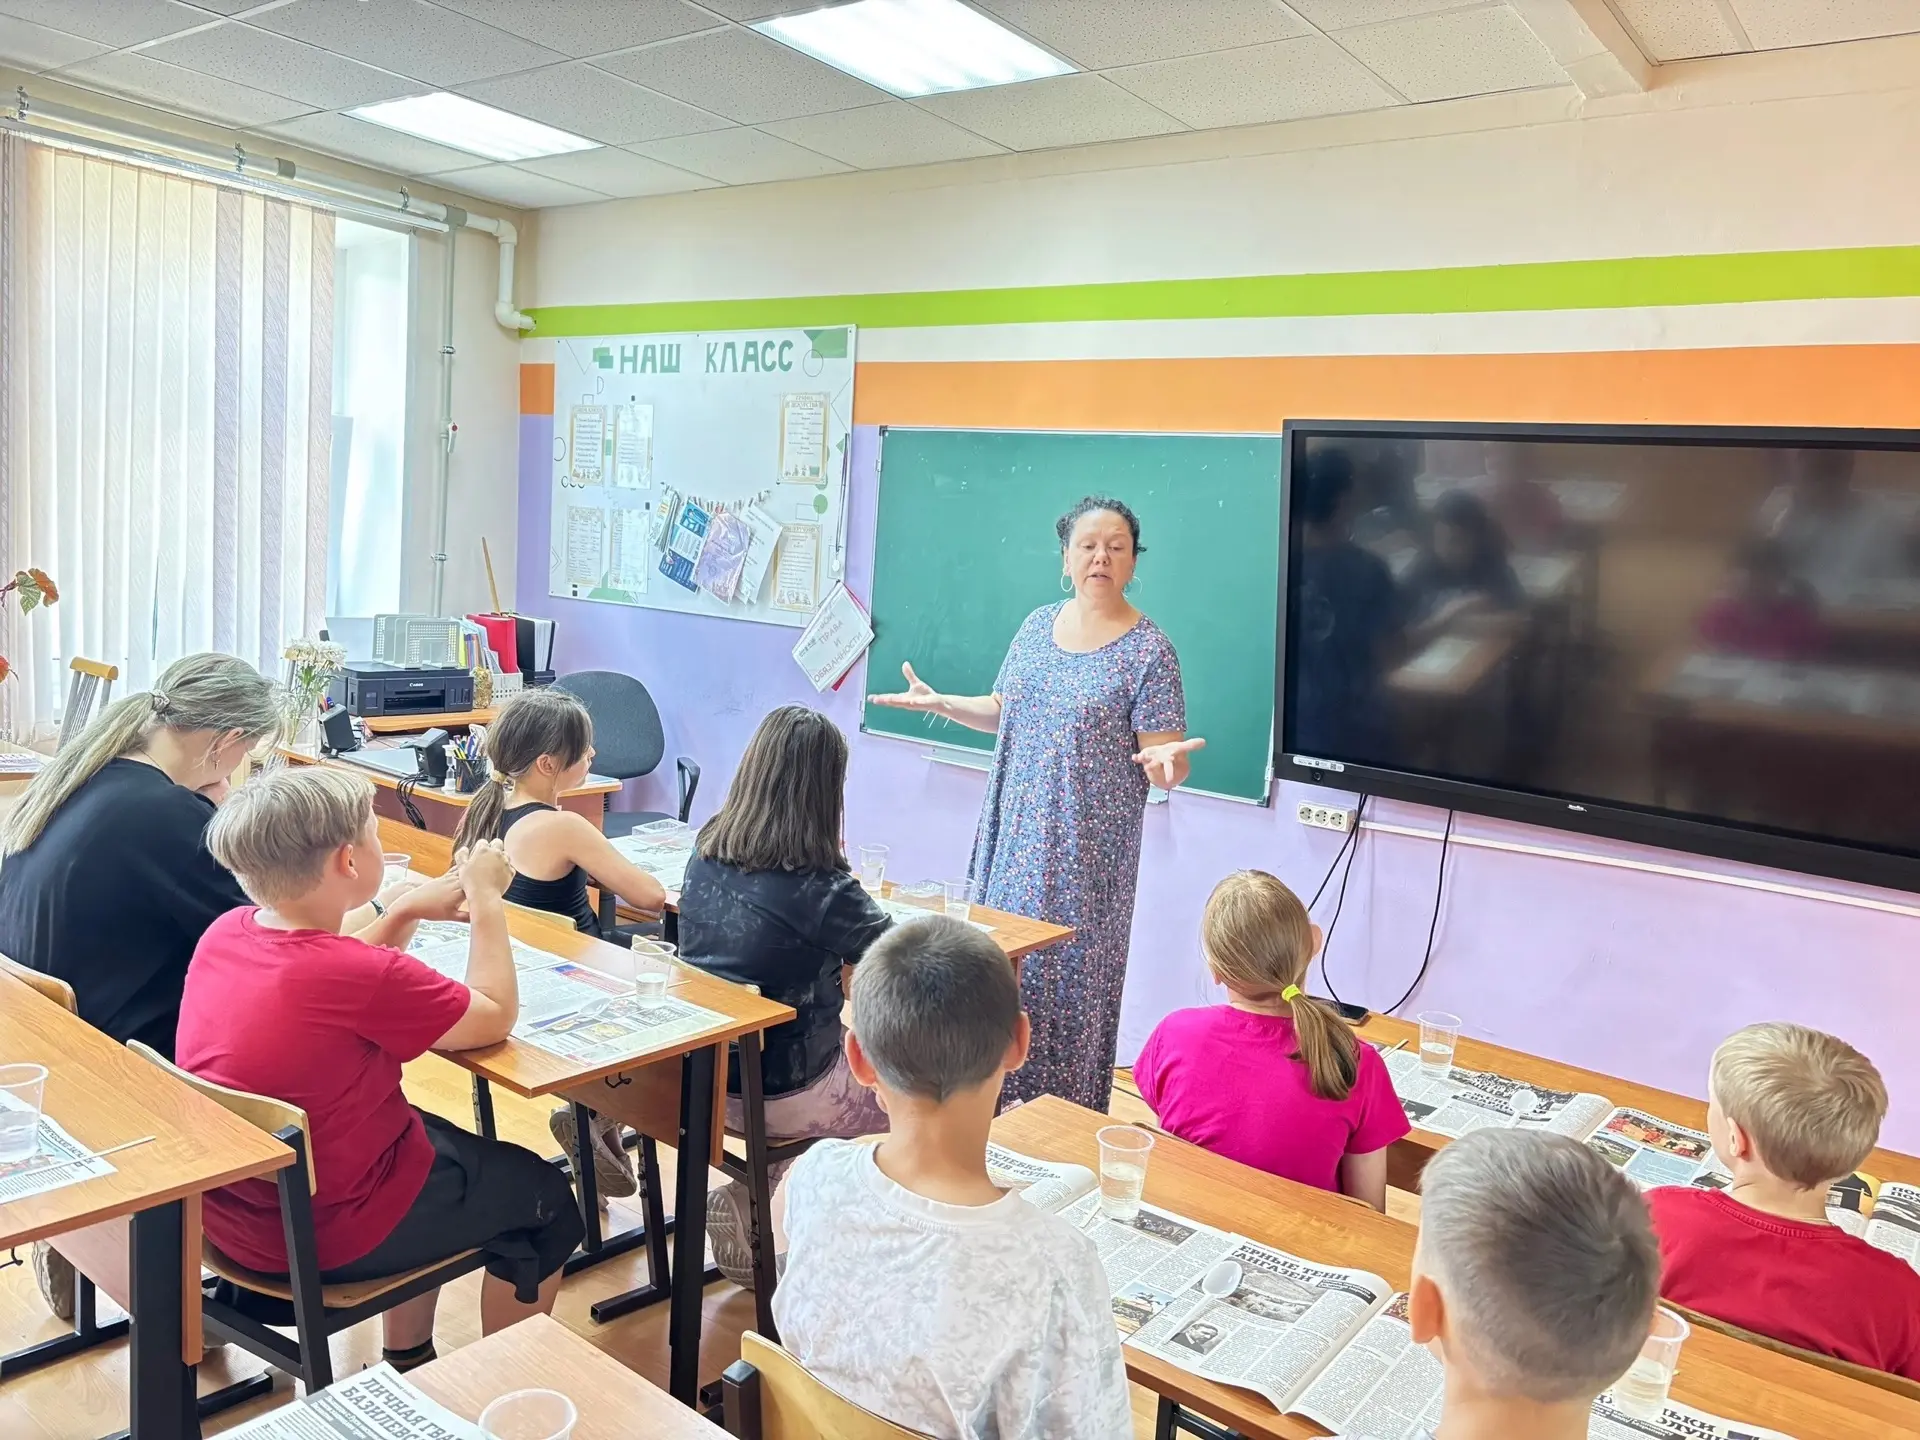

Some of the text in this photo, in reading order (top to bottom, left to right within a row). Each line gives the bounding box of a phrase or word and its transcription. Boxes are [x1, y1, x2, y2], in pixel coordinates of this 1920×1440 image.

[619, 340, 794, 374] НАШ КЛАСС
[819, 620, 844, 644] ПРАВА
[833, 639, 842, 648] И
[813, 631, 863, 683] ОБЯЗАННОСТИ
[340, 1386, 428, 1440] БАЗИЛЕВС
[360, 1377, 428, 1427] ЛИЧНАЯ
[418, 1422, 465, 1440] ГВА
